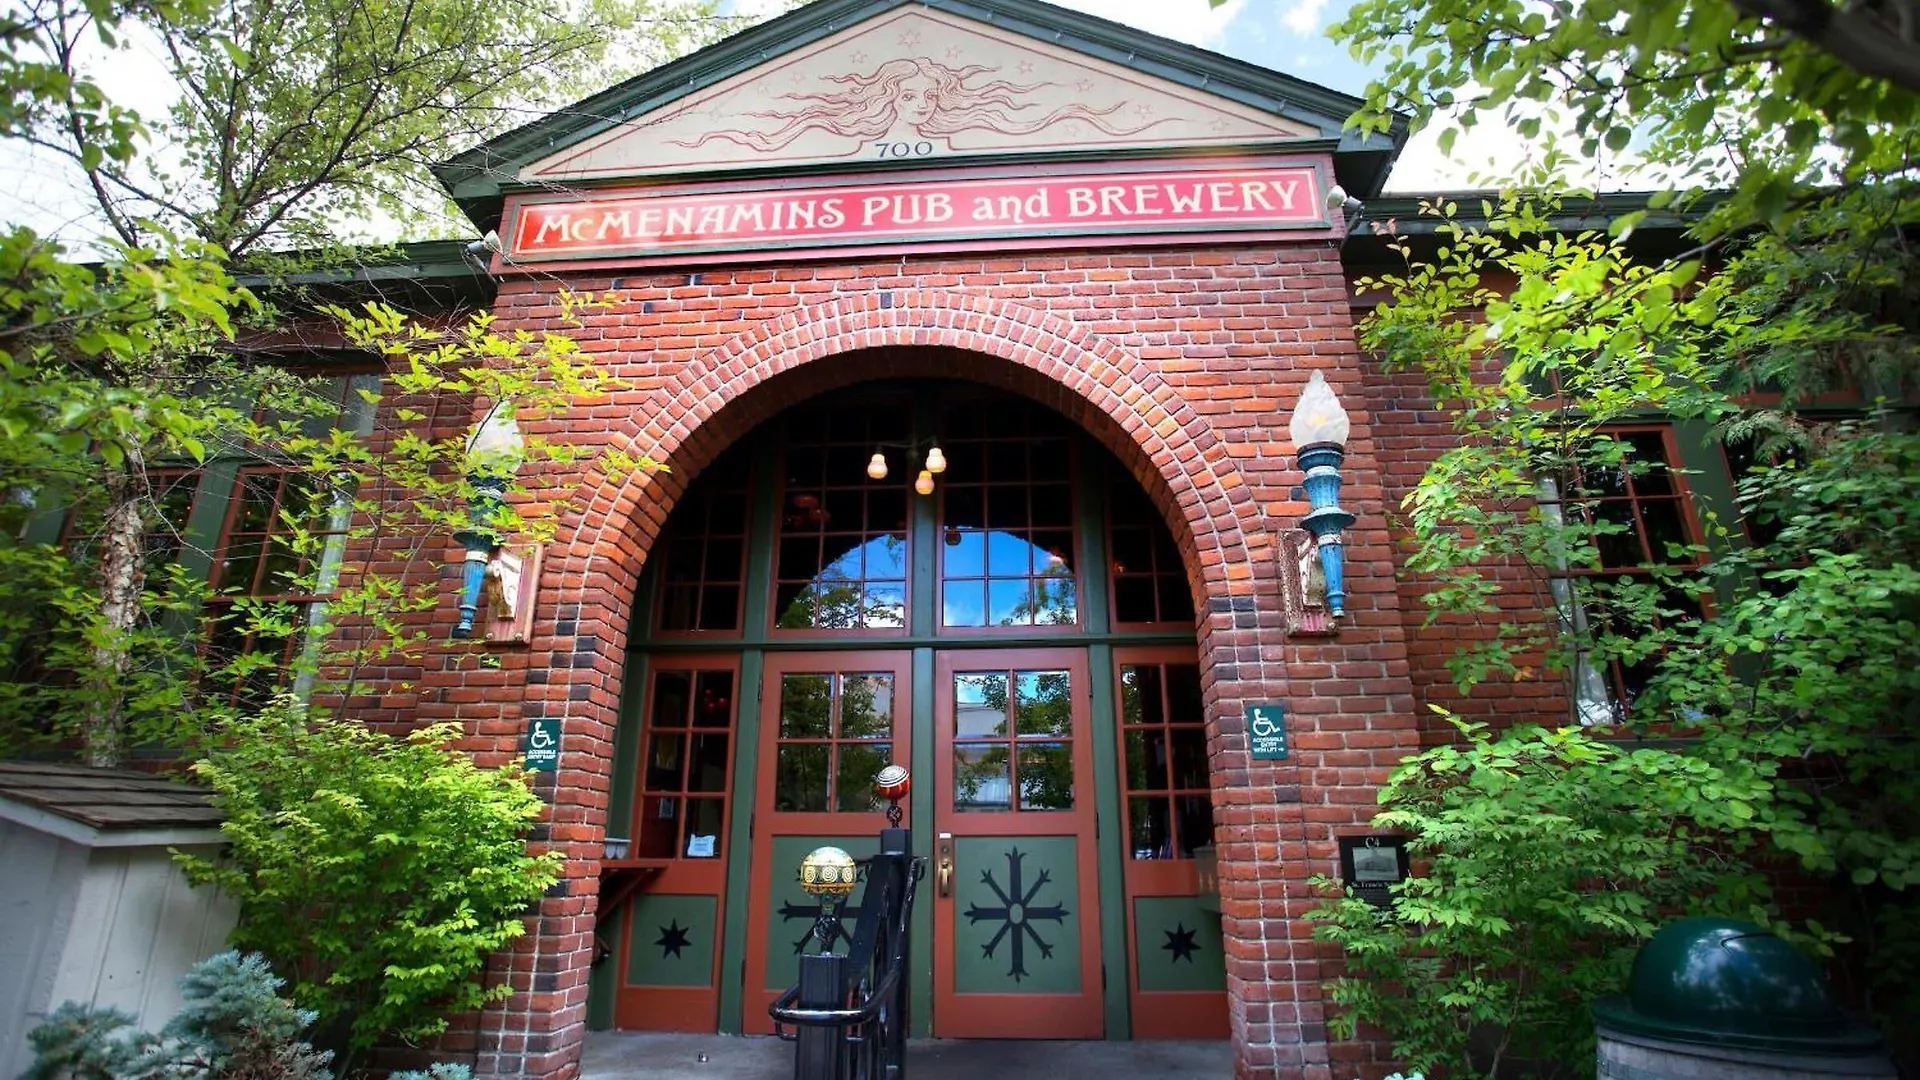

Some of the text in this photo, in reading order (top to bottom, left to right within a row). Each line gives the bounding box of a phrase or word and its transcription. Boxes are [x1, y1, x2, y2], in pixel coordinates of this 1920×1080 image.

[875, 139, 933, 158] 700
[533, 179, 1299, 243] McMENAMINS PUB and BREWERY
